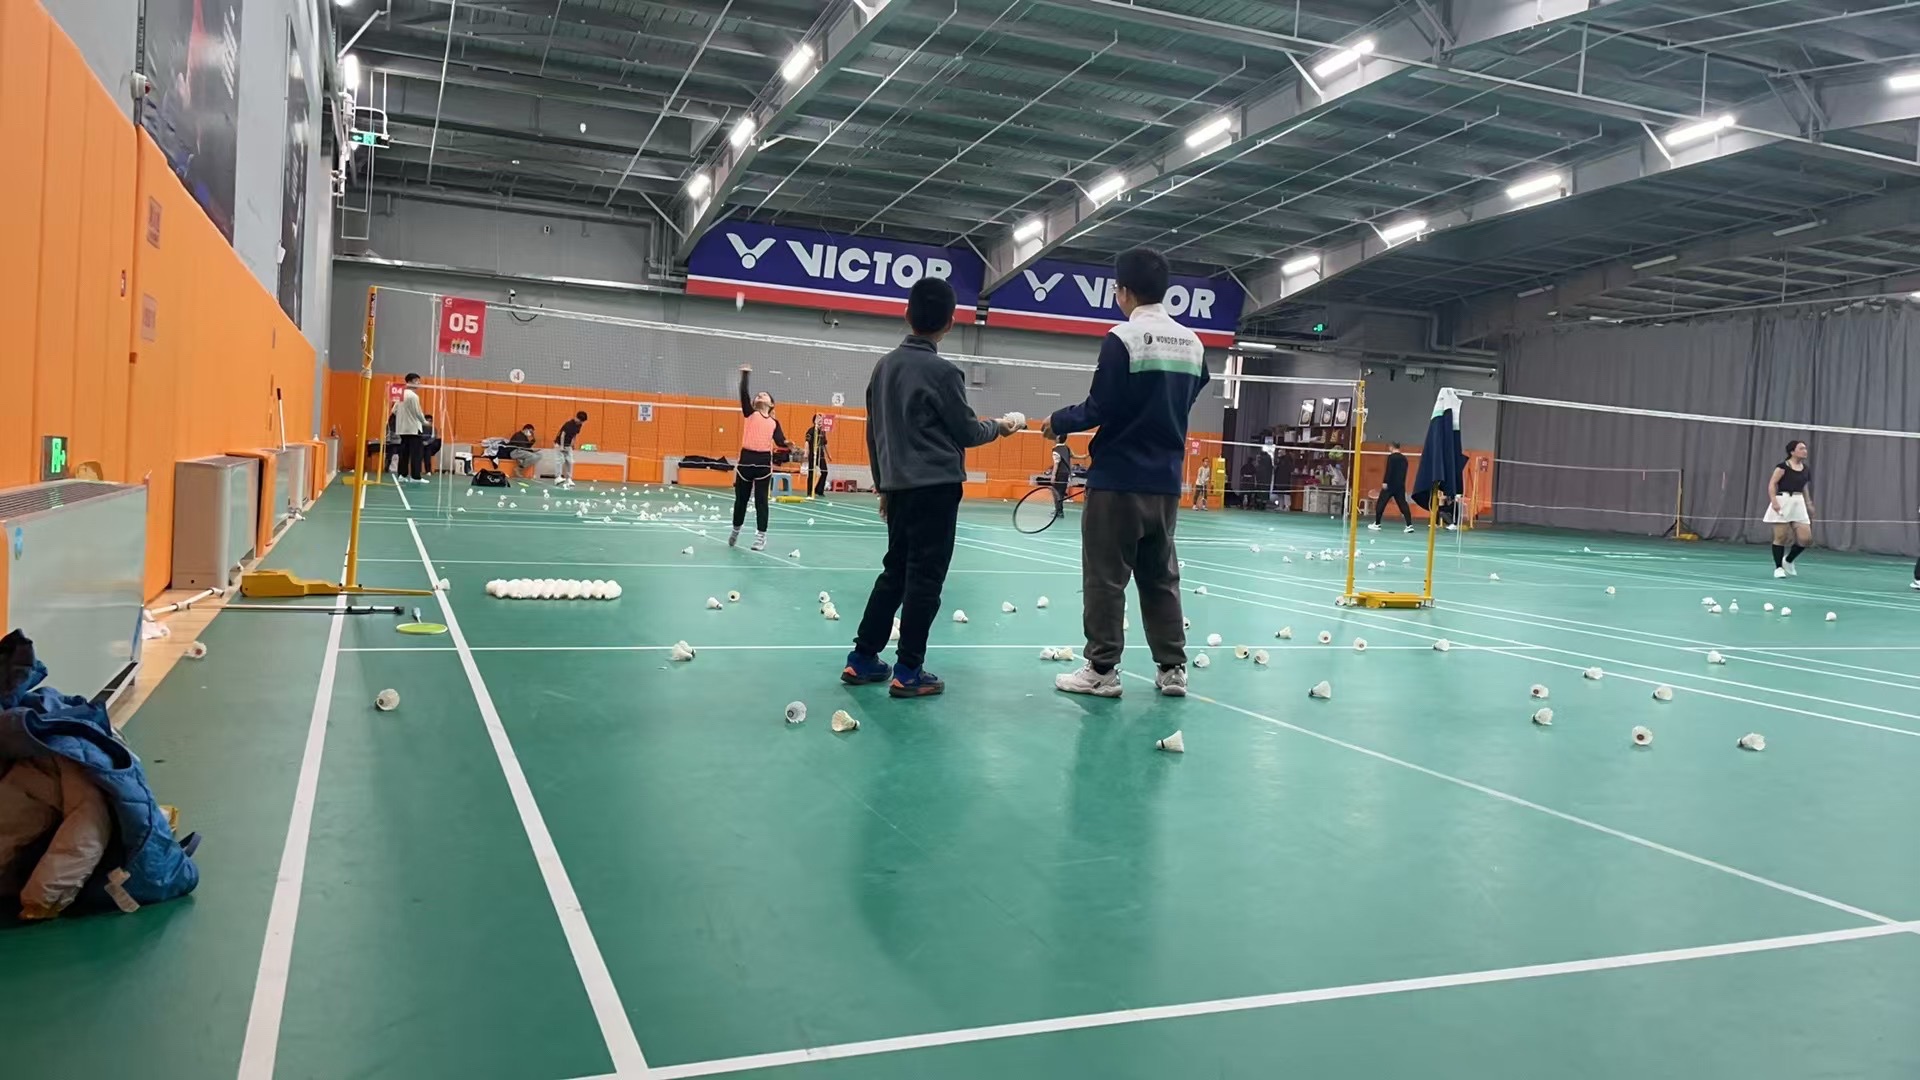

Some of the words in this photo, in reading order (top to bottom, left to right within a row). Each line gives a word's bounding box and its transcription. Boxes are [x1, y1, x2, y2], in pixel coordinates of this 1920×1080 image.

[786, 240, 953, 289] VICTOR
[1073, 274, 1216, 320] VIOR
[449, 312, 479, 334] 05
[1155, 335, 1178, 345] WONDER
[391, 386, 403, 395] 04
[834, 395, 841, 404] 3
